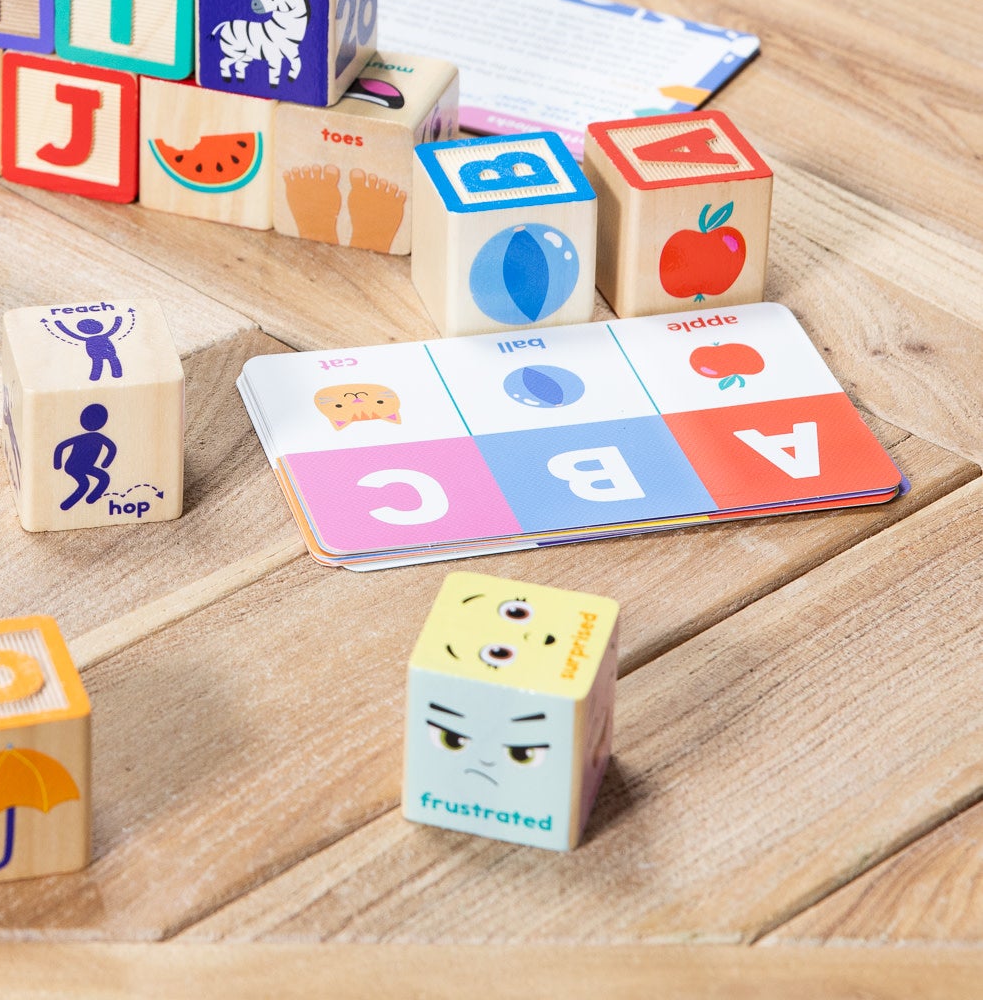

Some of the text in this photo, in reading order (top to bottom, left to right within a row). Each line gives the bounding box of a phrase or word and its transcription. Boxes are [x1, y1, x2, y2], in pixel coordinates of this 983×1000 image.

[36, 83, 102, 167] J
[321, 128, 364, 147] toes
[632, 127, 739, 165] A
[458, 151, 559, 193] B
[50, 302, 115, 315] reach
[667, 314, 738, 333] apple
[318, 357, 359, 371] cat
[497, 338, 546, 354] ball
[732, 421, 821, 480] A
[547, 445, 646, 502] B
[108, 501, 151, 518] hop
[356, 469, 449, 525] C
[420, 792, 553, 831] frustrated
